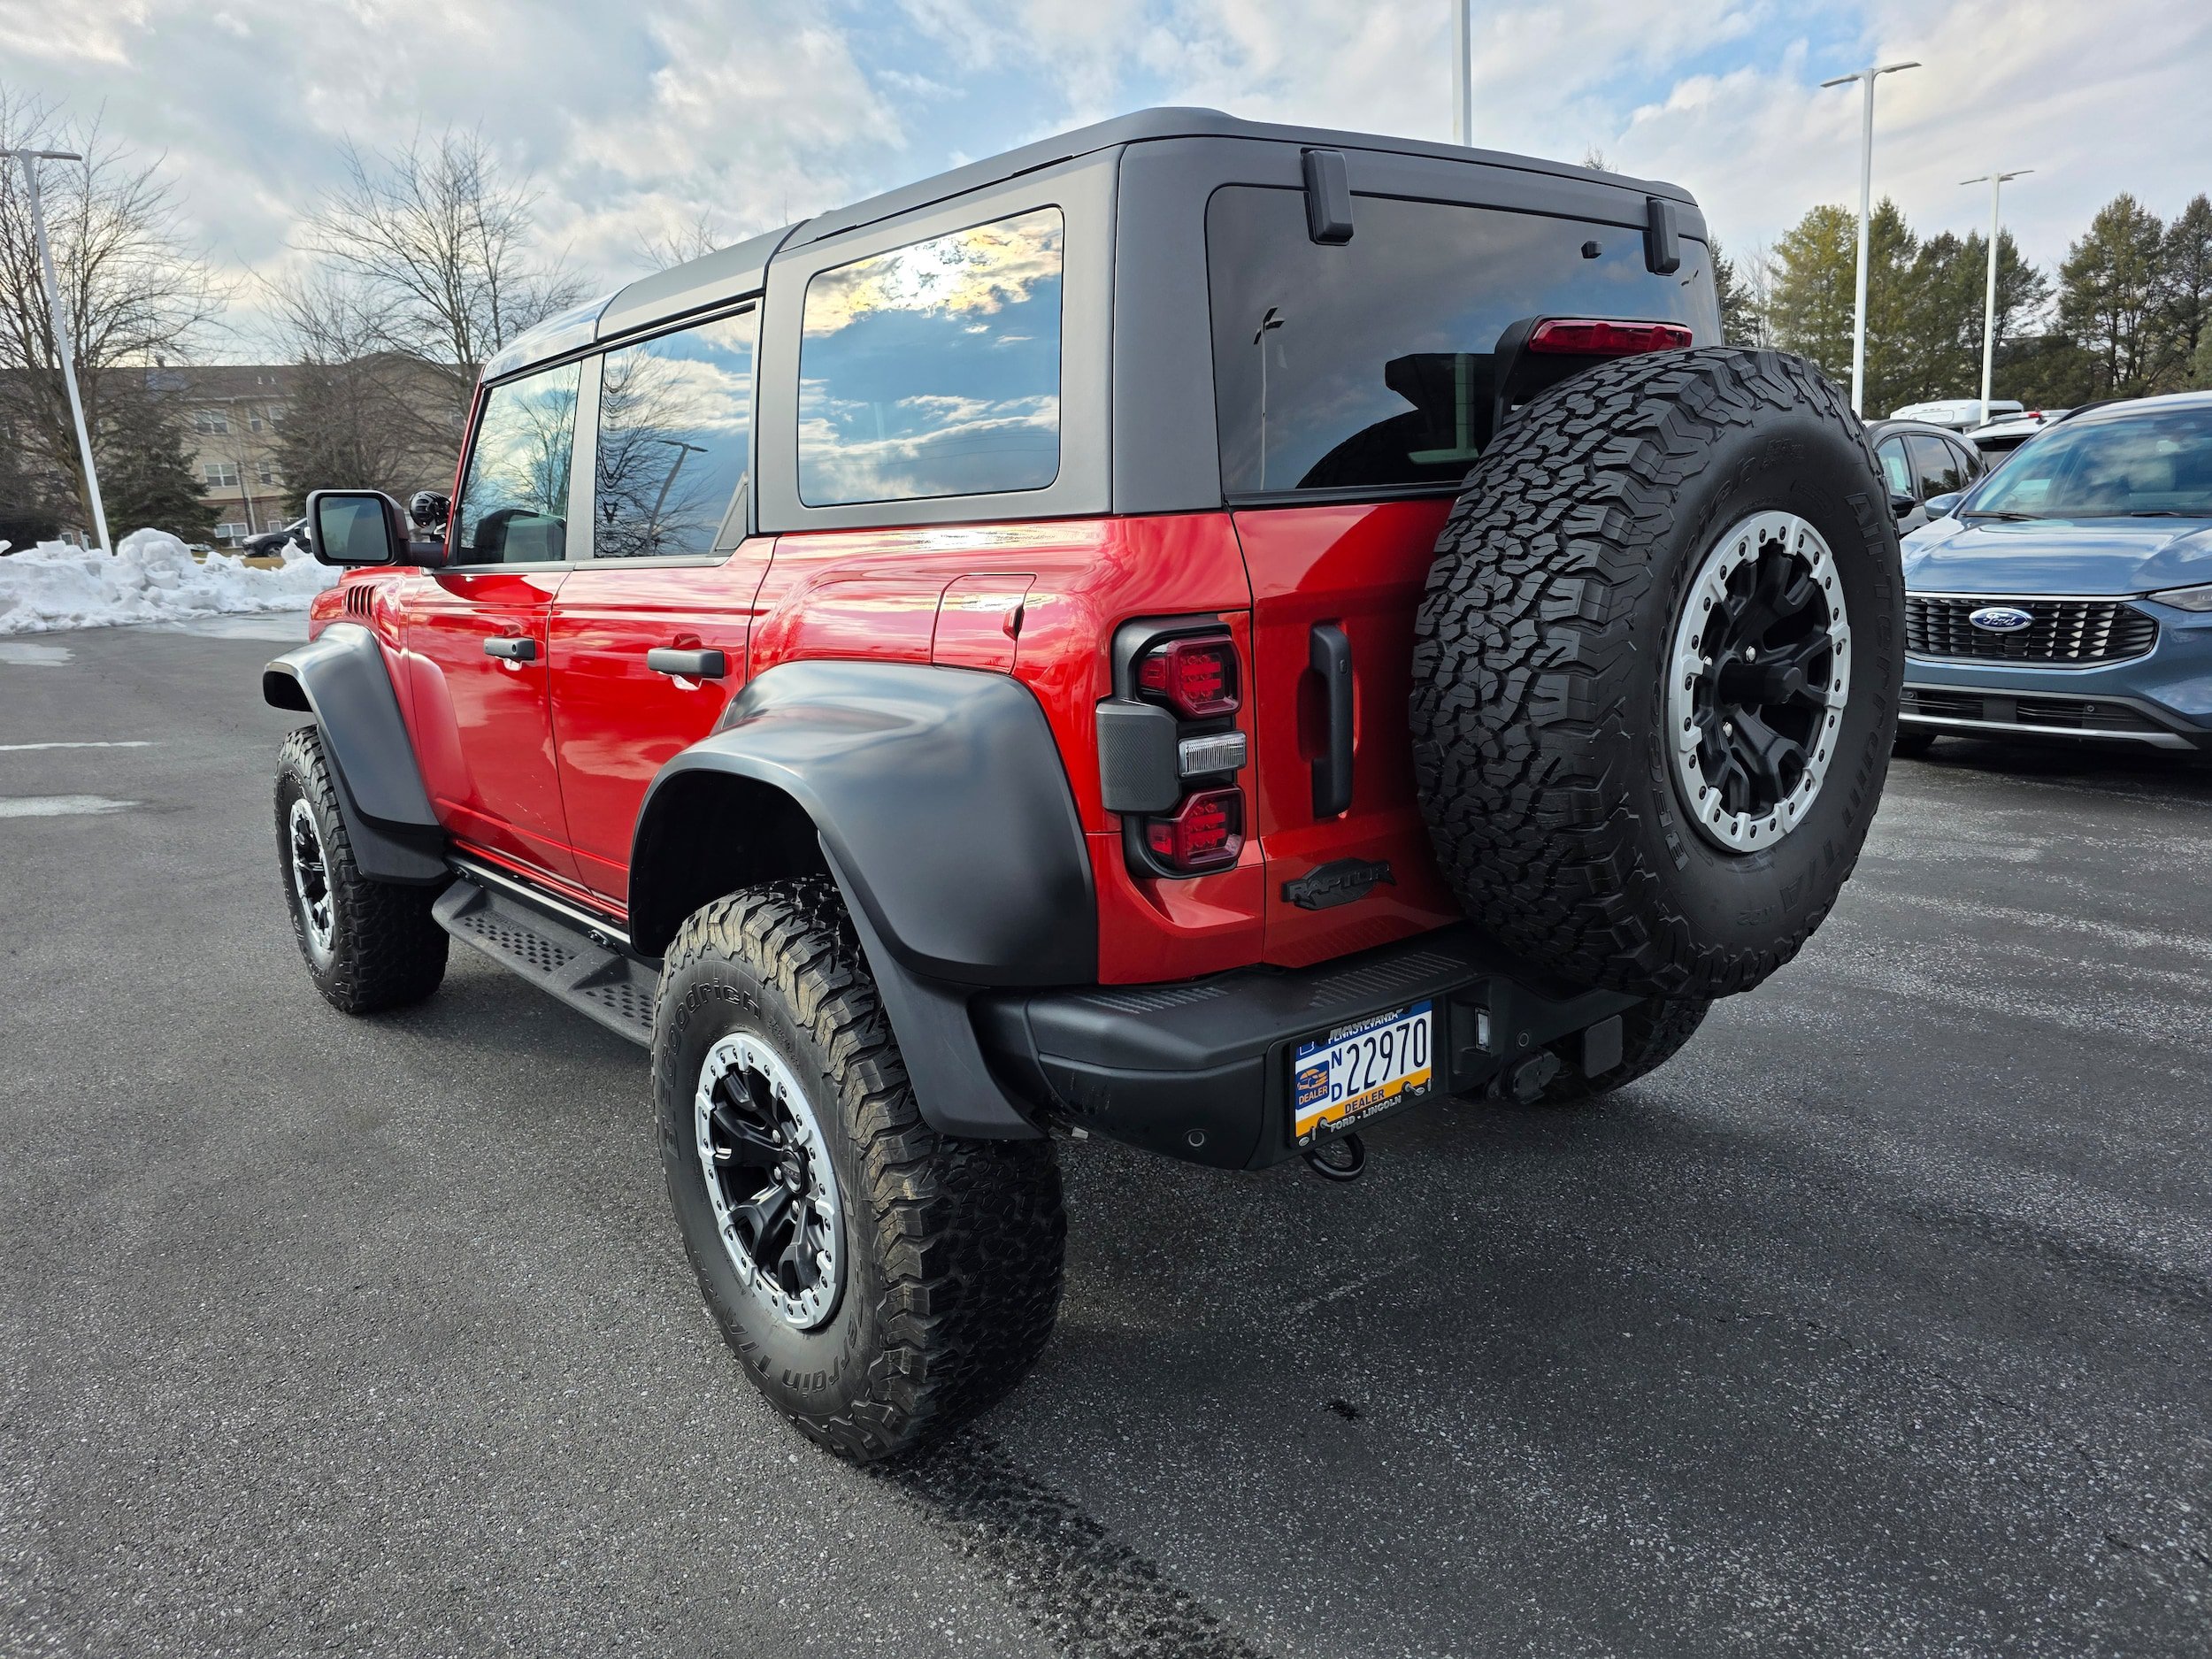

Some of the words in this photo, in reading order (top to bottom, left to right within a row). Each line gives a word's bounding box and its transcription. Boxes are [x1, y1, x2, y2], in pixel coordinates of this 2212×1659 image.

[1983, 612, 2016, 626] Ford
[660, 977, 762, 1160] BFGoodrich
[1347, 1018, 1427, 1098] 22970
[1298, 1086, 1328, 1106] DEALER
[1345, 1088, 1385, 1114] DEALER
[1330, 1115, 1356, 1133] FORD
[1363, 1094, 1402, 1118] LINCOLN
